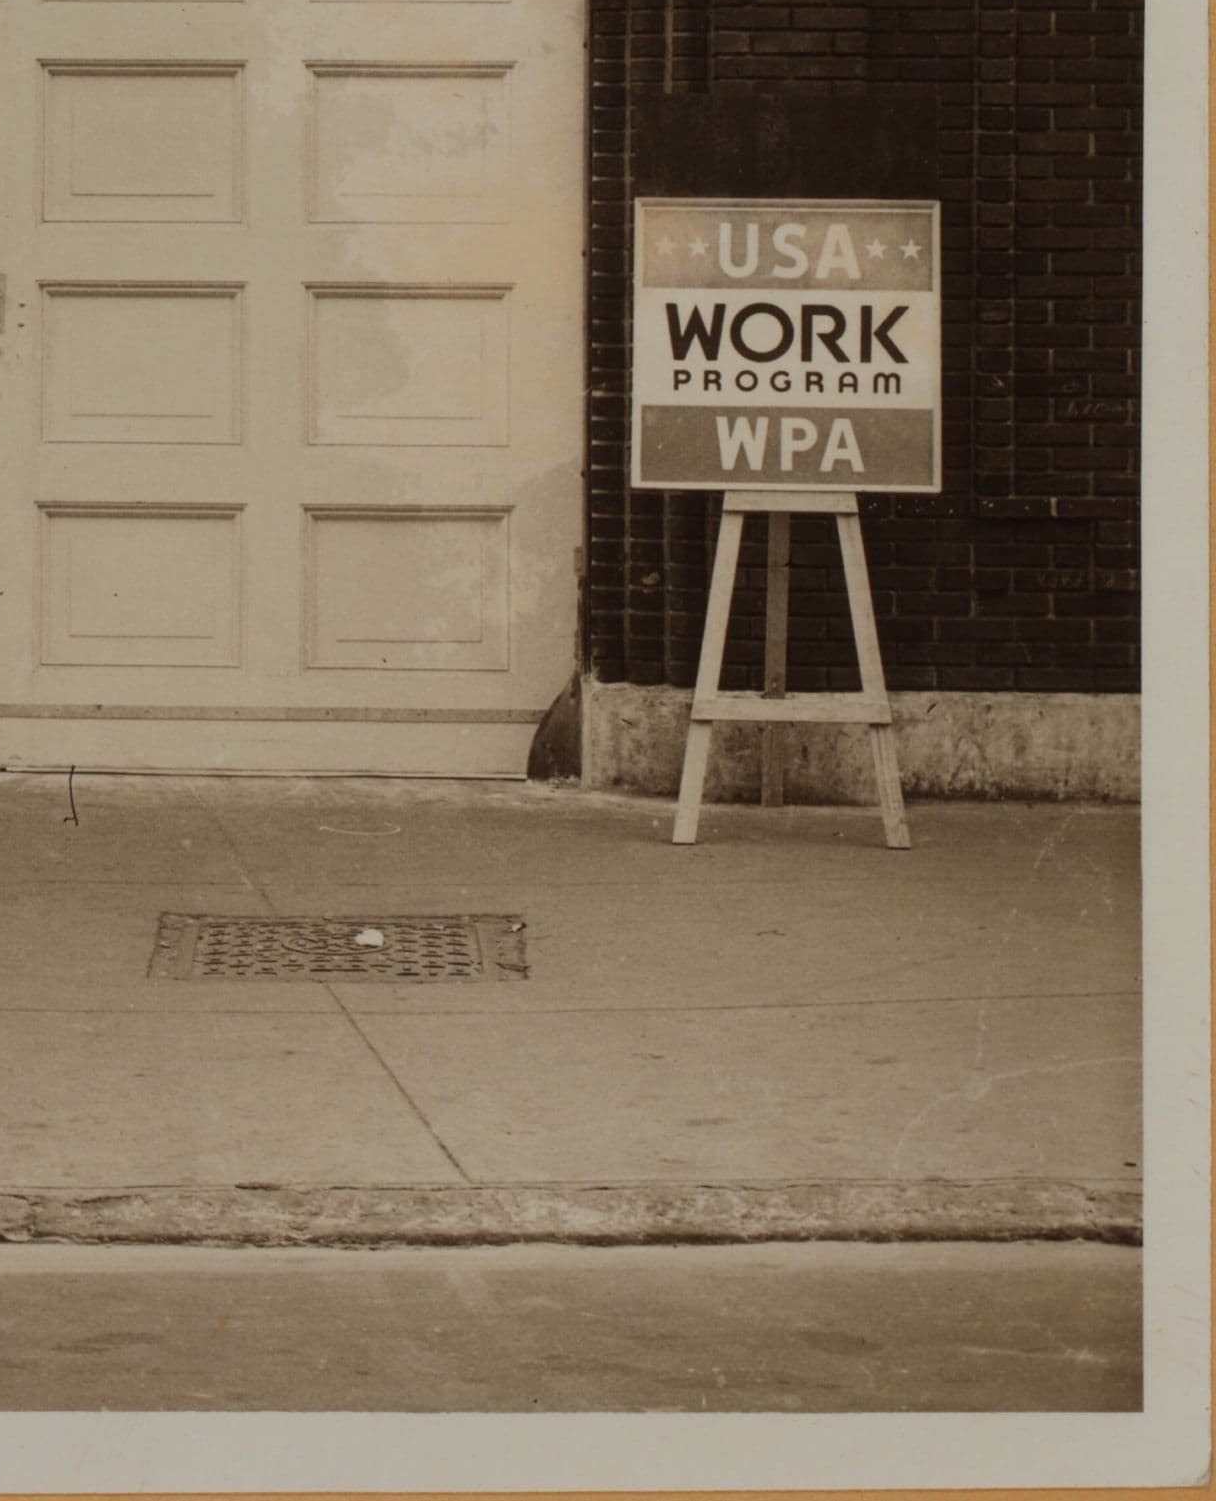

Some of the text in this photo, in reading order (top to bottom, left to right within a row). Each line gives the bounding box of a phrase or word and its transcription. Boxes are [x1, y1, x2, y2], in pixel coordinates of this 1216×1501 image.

[718, 222, 862, 280] USA
[665, 302, 910, 364] WORK
[673, 369, 902, 395] PROGRAM
[715, 415, 865, 473] WPA
